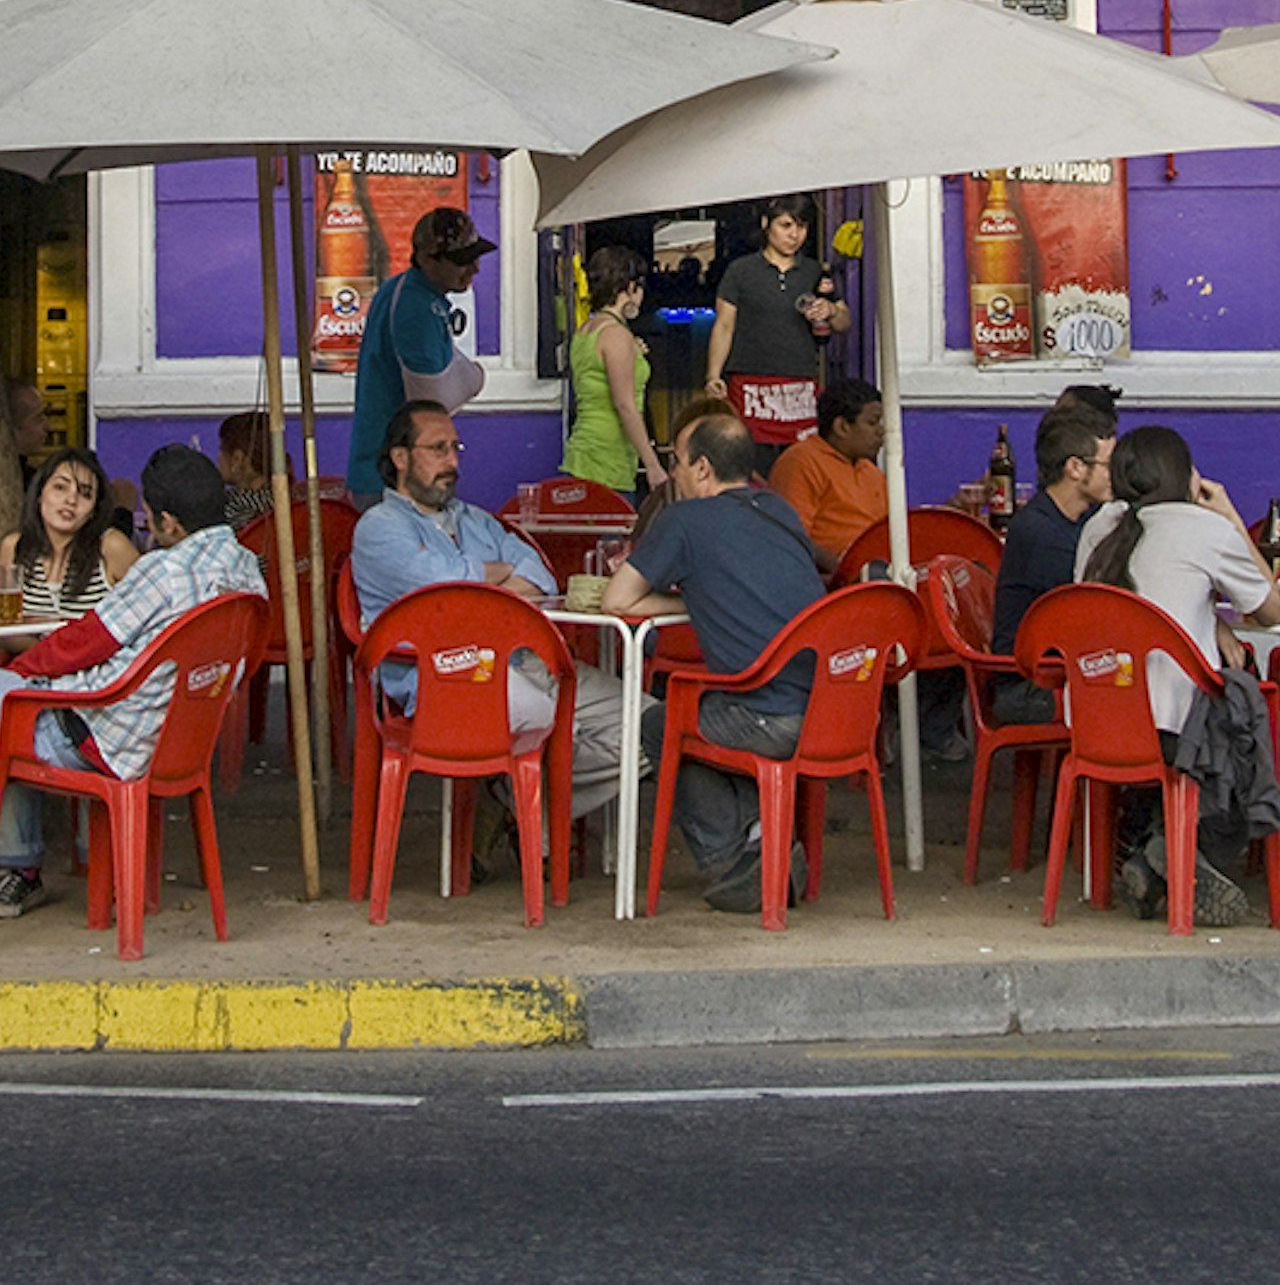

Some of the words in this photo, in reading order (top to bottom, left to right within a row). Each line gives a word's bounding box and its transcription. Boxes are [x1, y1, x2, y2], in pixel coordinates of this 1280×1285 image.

[366, 150, 457, 176] ACOMPAÑO
[975, 323, 1030, 342] Escudo
[1043, 327, 1056, 349] $
[1070, 319, 1113, 352] 1000
